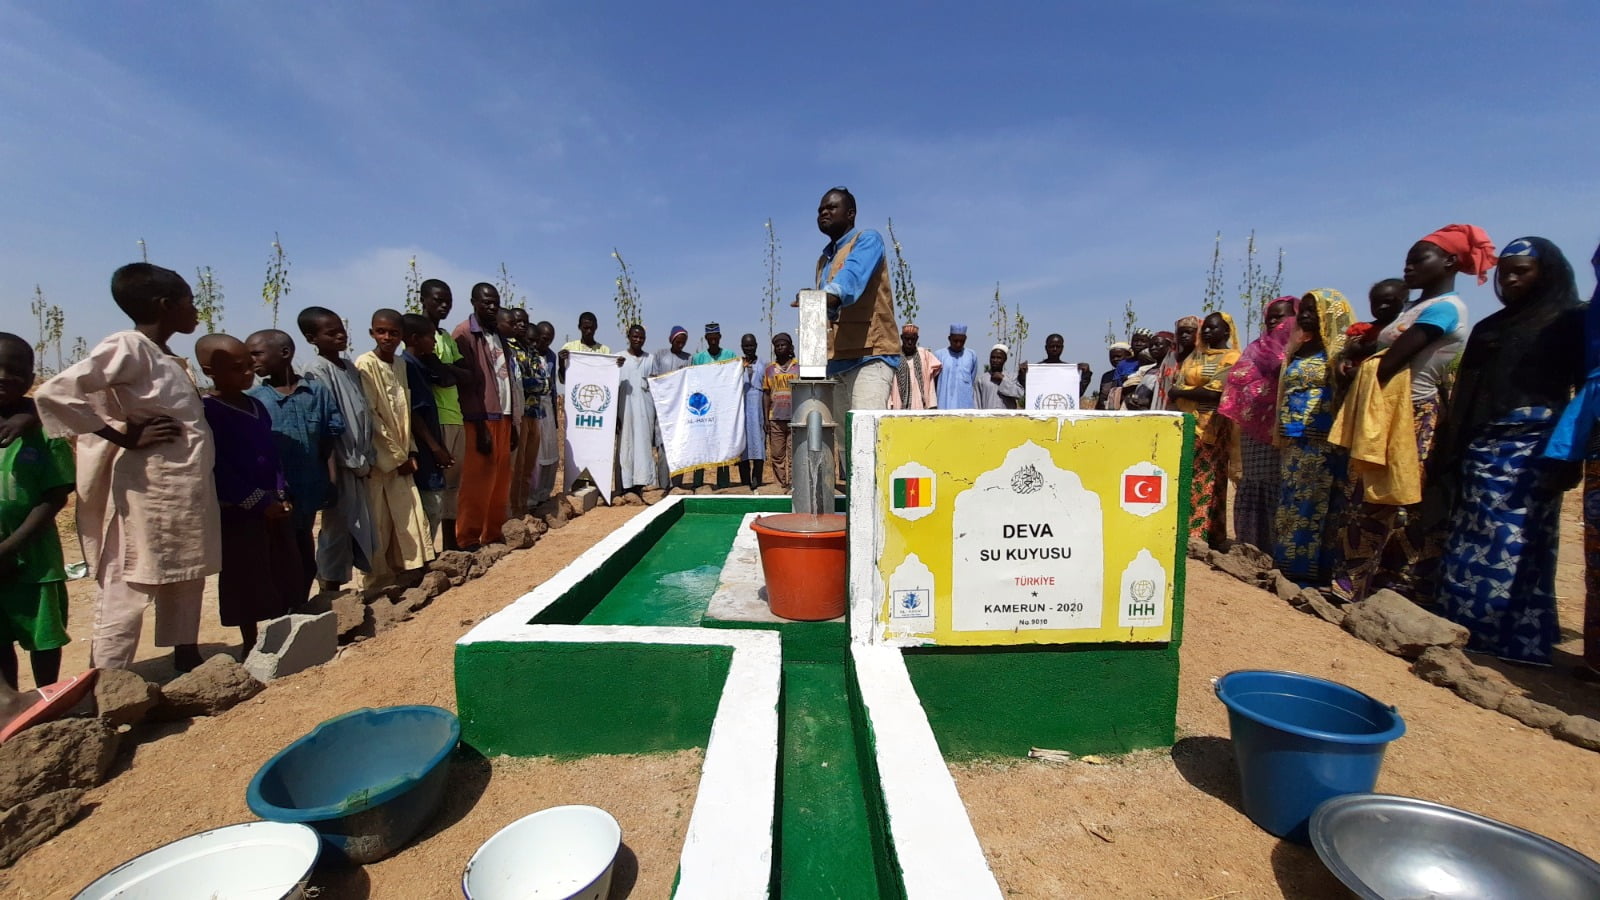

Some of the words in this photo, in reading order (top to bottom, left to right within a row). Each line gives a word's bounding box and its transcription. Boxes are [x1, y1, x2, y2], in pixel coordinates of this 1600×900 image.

[1003, 523, 1054, 539] DEVA
[980, 549, 1001, 562] SU
[1006, 546, 1072, 561] KUYUSU
[1014, 575, 1056, 587] TÜRKİYE
[984, 603, 1046, 614] KAMERUN
[1056, 602, 1084, 613] 2020
[1128, 603, 1155, 617] IHH
